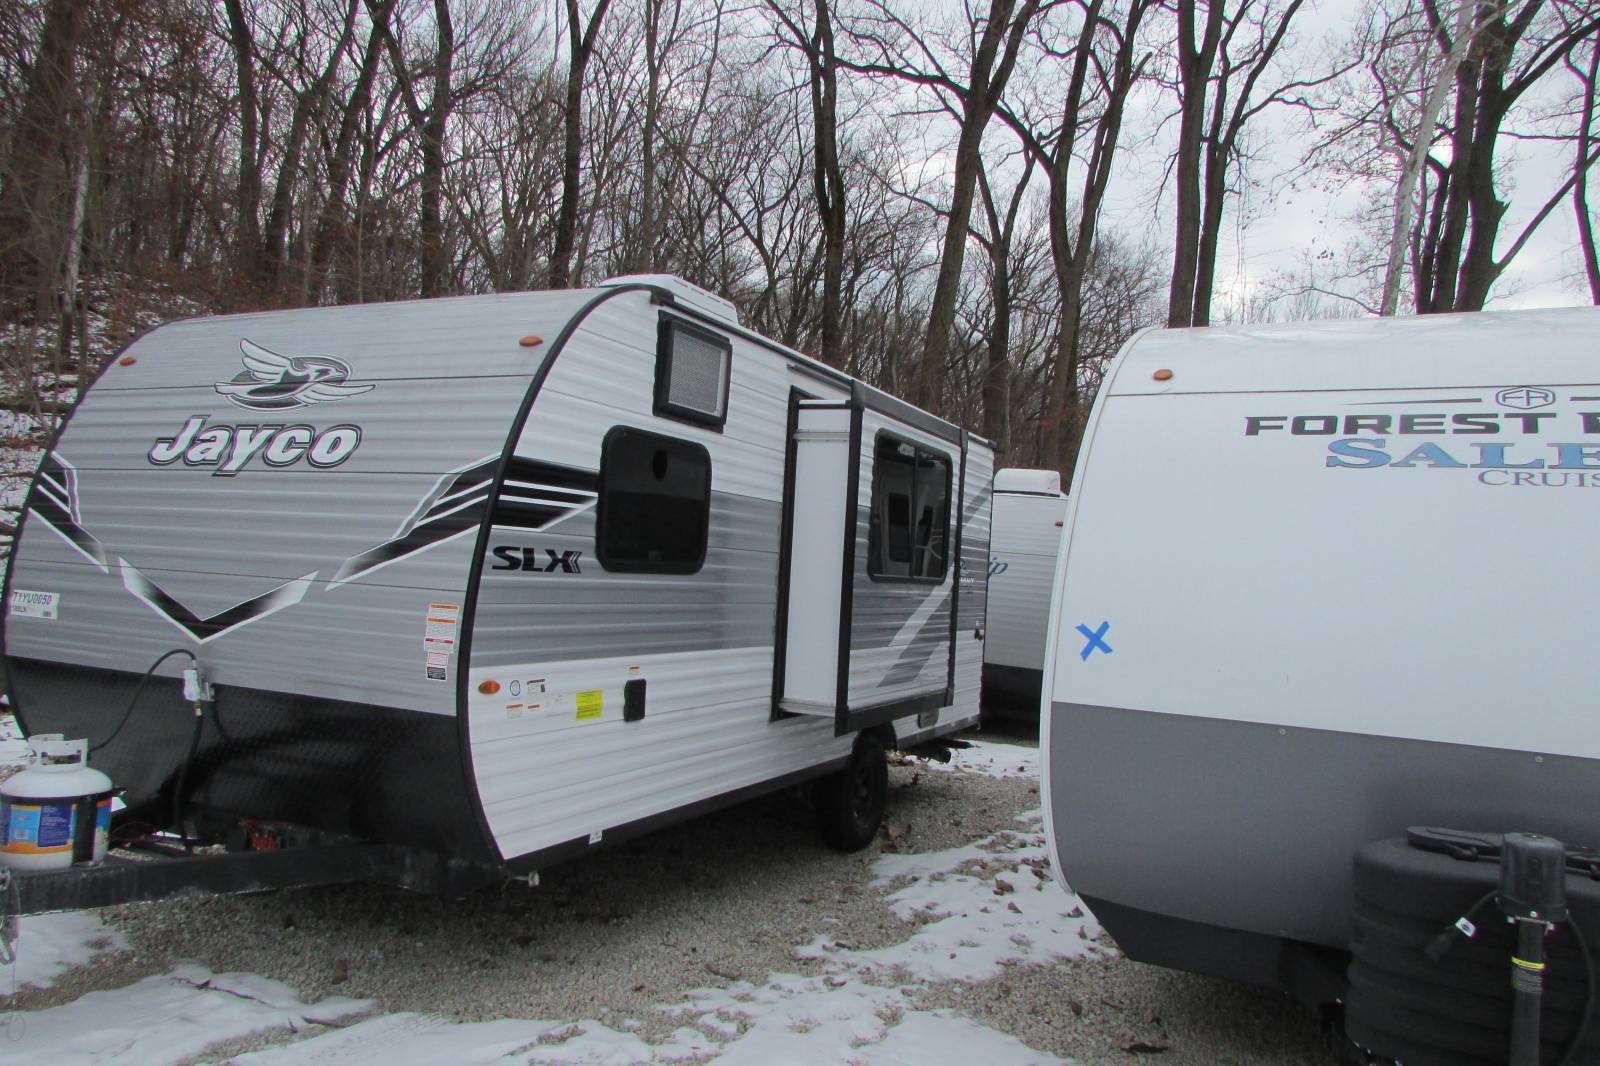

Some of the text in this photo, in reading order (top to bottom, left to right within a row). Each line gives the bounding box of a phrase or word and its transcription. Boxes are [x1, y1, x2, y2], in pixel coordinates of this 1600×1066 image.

[1245, 412, 1557, 436] FOREST
[148, 414, 363, 477] Jayco
[491, 546, 582, 574] SLX
